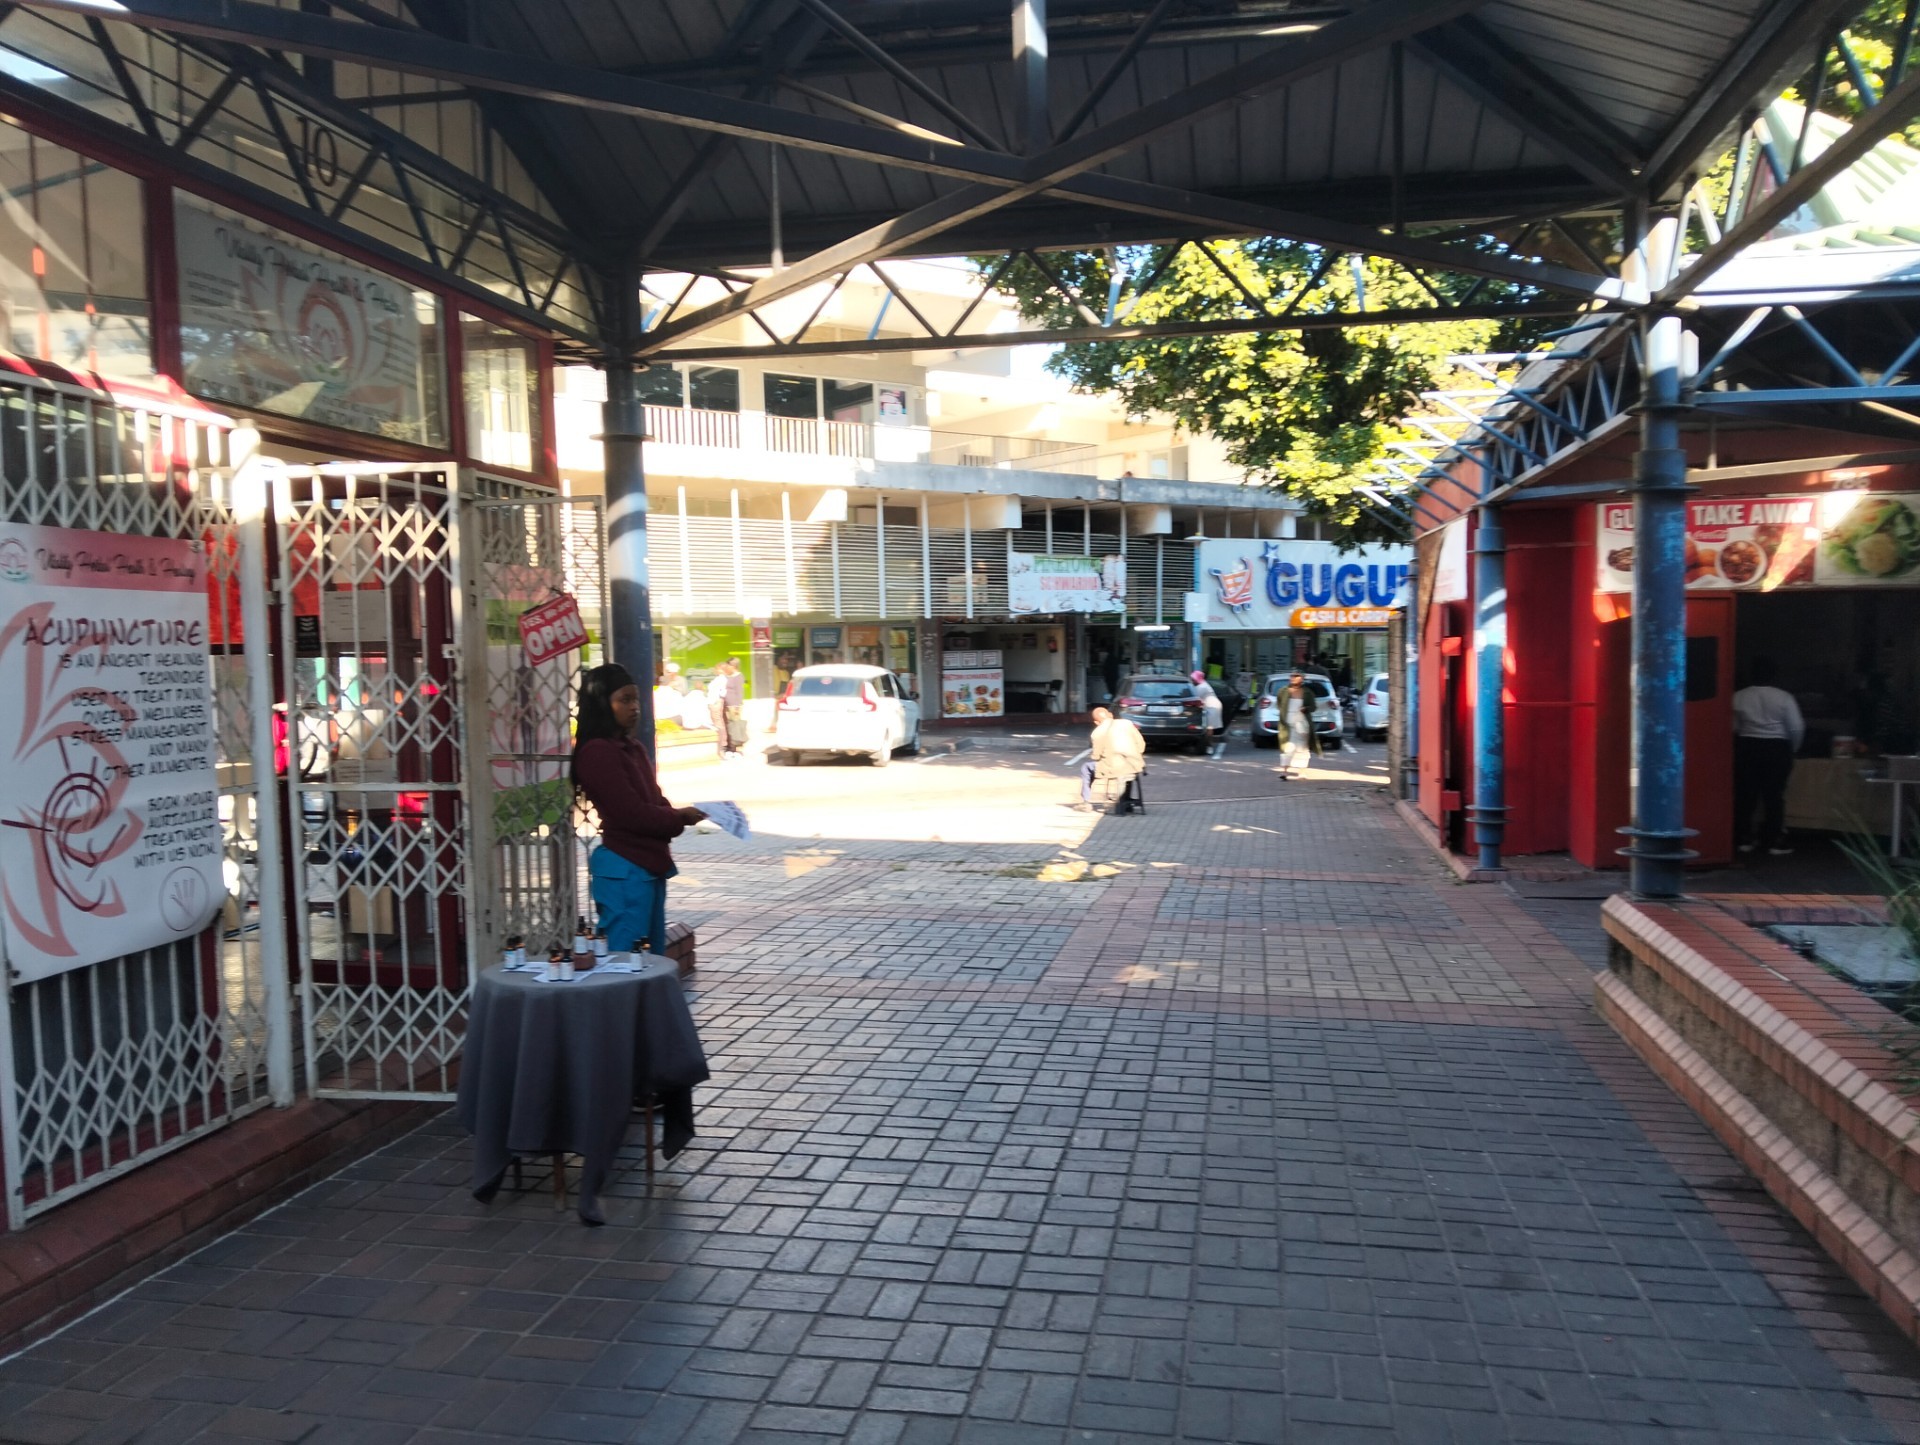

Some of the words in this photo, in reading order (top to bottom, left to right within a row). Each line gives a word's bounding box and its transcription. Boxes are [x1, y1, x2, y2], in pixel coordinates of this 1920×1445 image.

[1692, 505, 1746, 527] TAKE
[1750, 502, 1814, 524] AWAY
[1300, 611, 1336, 624] CASH
[1337, 611, 1347, 623] &
[22, 617, 203, 647] ACUPUNCTURE
[526, 611, 583, 656] OPEN
[77, 653, 95, 667] AN
[100, 653, 152, 668] ANCIENT
[154, 652, 205, 667] HEALING
[138, 670, 206, 686] TECHNIQUE
[72, 691, 108, 707] USED
[133, 689, 173, 703] TREAT
[83, 710, 140, 726] OVERALL
[72, 728, 122, 746] STRESS
[126, 721, 208, 741] MANAGEMENT
[149, 742, 174, 757] AND
[176, 739, 209, 755] MANY
[103, 763, 145, 781] OTHER
[148, 796, 179, 812] BOOK
[183, 790, 213, 807] YOUR
[143, 824, 215, 850] TREATMENT
[133, 850, 166, 869] WITH
[168, 846, 186, 862] US
